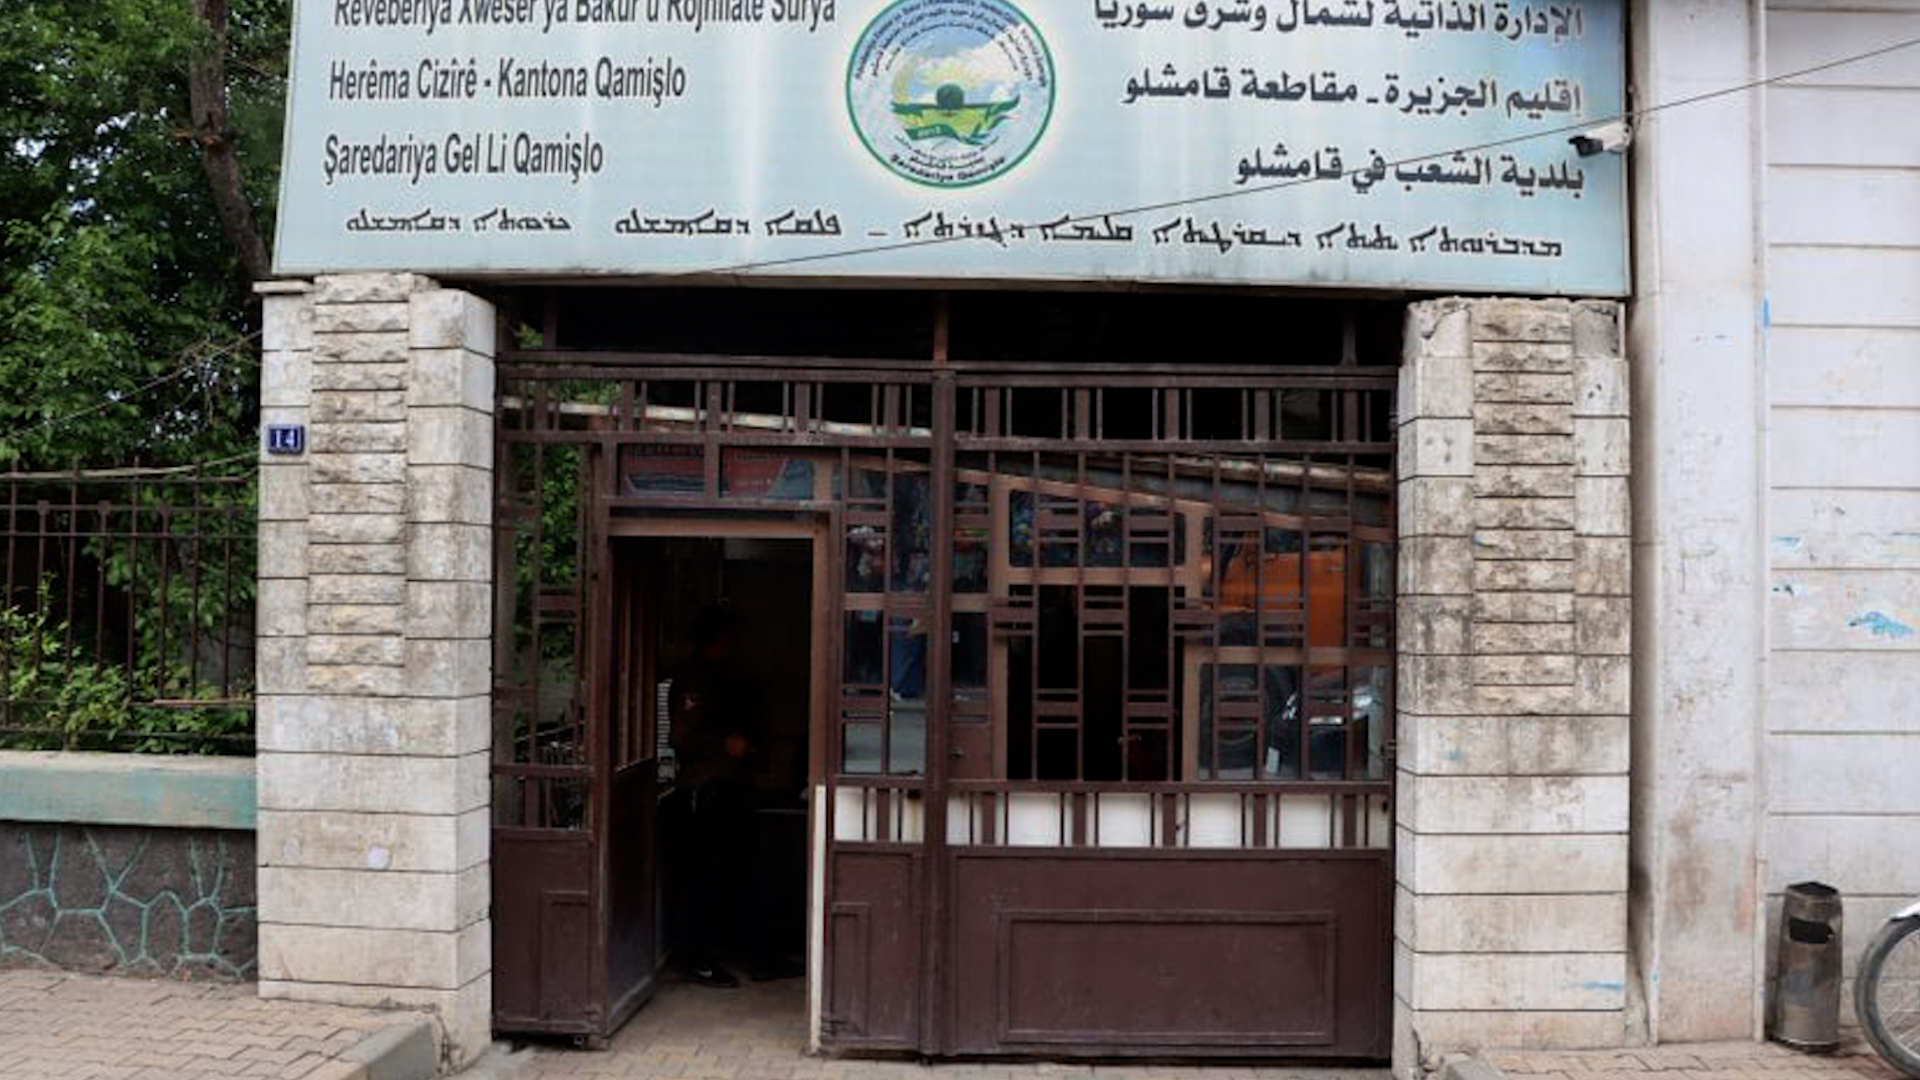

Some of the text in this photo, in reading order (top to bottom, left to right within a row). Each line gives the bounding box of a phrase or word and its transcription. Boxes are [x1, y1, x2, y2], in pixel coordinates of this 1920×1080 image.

[542, 0, 569, 35] ya
[575, 0, 638, 23] Bakur
[1094, 0, 1175, 30] سوريا
[1275, 0, 1375, 34] لشمال
[1382, 0, 1487, 39] الذاتية
[1494, 1, 1584, 41] الإدارة
[329, 58, 410, 101] Herêma
[416, 57, 478, 100] Cizîrê
[497, 57, 589, 98] Kantona
[594, 56, 686, 109] Qamişlo
[1121, 62, 1232, 105] قامشلو
[1239, 67, 1359, 103] مقاطعة
[1384, 73, 1498, 117] الجزيرة
[323, 131, 604, 186] Şaredariya Gel Li Qamişlo
[1234, 143, 1586, 200] بلدية الشعب في قامشلو
[276, 429, 295, 448] 14
